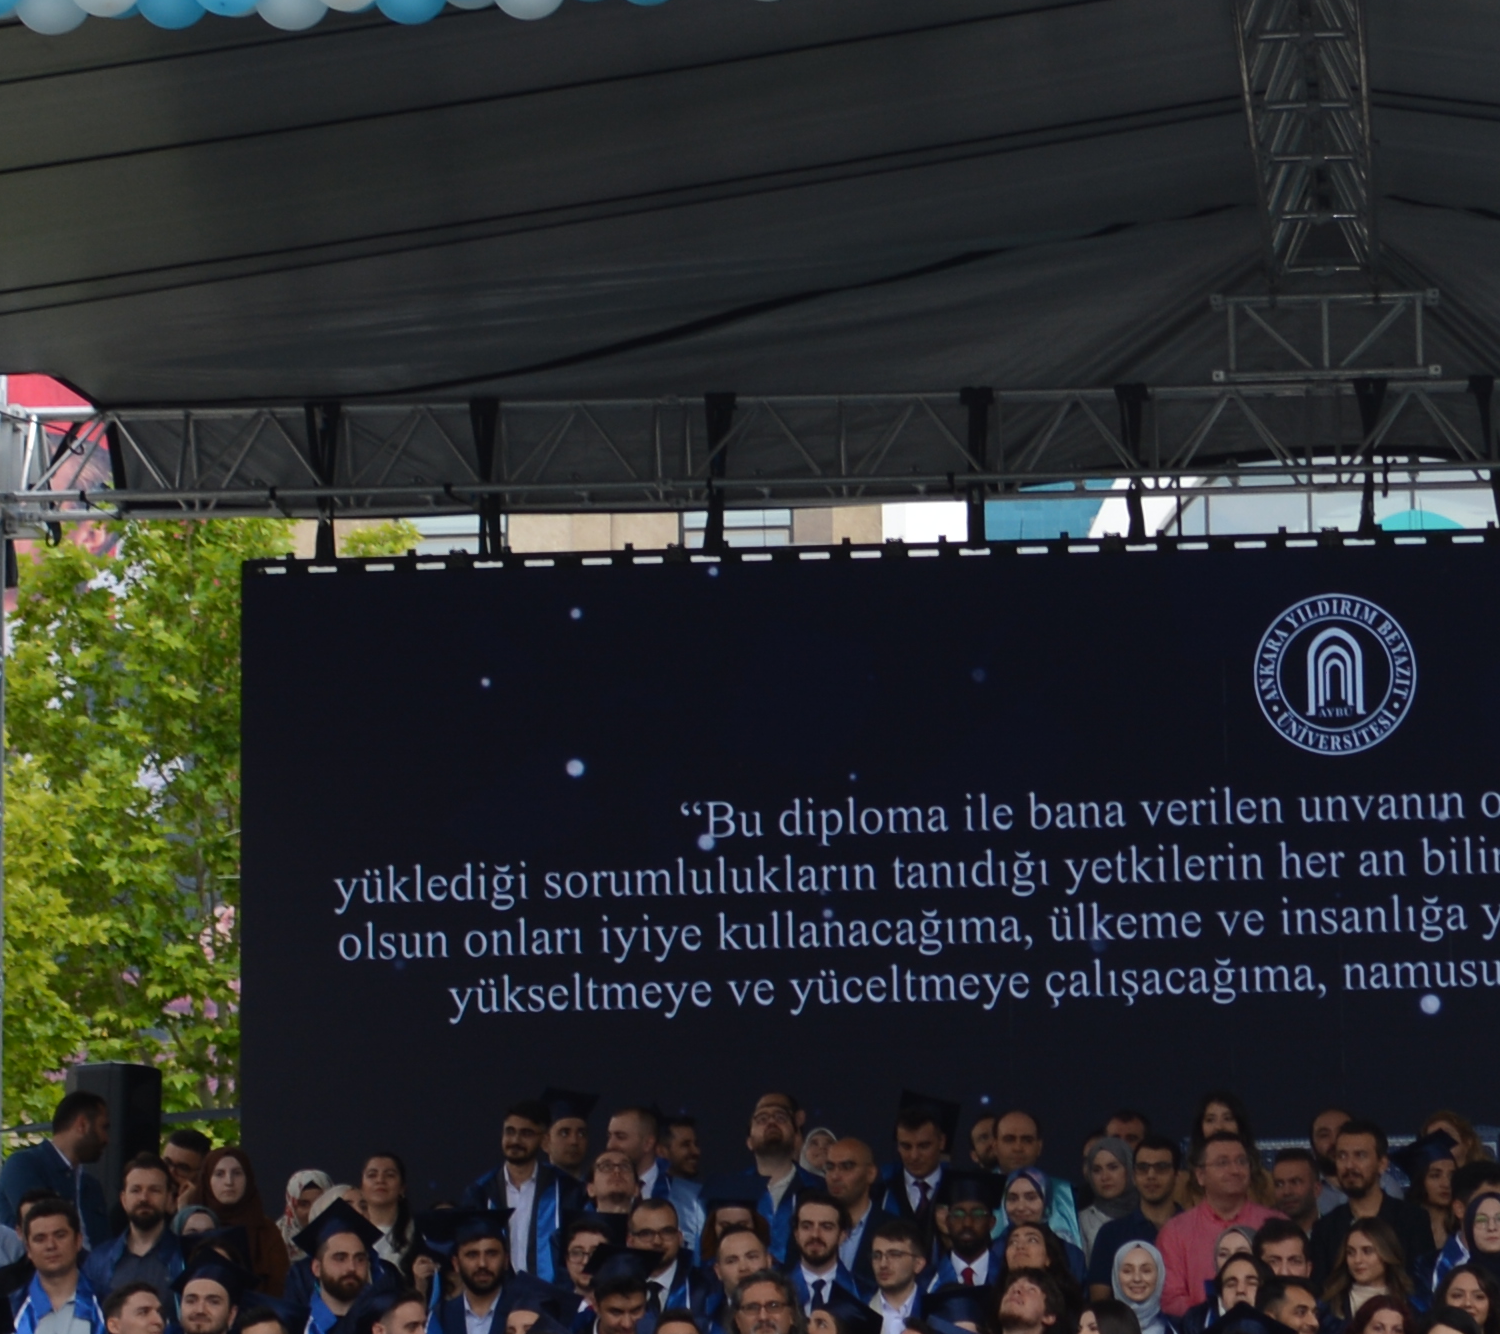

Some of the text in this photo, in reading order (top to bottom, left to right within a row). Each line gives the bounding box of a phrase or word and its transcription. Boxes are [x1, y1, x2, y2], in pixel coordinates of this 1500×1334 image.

[1259, 599, 1411, 701] ANKARA YILDIRIM BEYAZIT
[1276, 708, 1397, 751] ÜNİVERSİTESİ
[779, 796, 949, 847] diploma
[965, 793, 1013, 832] ile
[1028, 791, 1126, 830] bana
[1141, 786, 1283, 826] verilen
[1299, 793, 1465, 823] unvanın
[334, 861, 526, 914] yüklediği
[545, 854, 875, 898] sorumlulukların
[894, 849, 1047, 896] tanıdığı
[1065, 843, 1263, 895] yetkilerin
[1280, 841, 1344, 878] her
[1360, 850, 1405, 876] an
[339, 922, 447, 960] olsun
[465, 917, 581, 957] onları
[602, 914, 701, 963] iyiye
[719, 910, 1032, 955] kullanacağıma,
[1050, 902, 1201, 941] ülkeme
[1217, 910, 1264, 936] ve
[1282, 894, 1467, 942] insanlığa
[449, 972, 711, 1024] yükseltmeye
[728, 980, 774, 1005] ve
[790, 964, 1029, 1015] yüceltmeye
[1046, 959, 1326, 1007] çalışacağıma,
